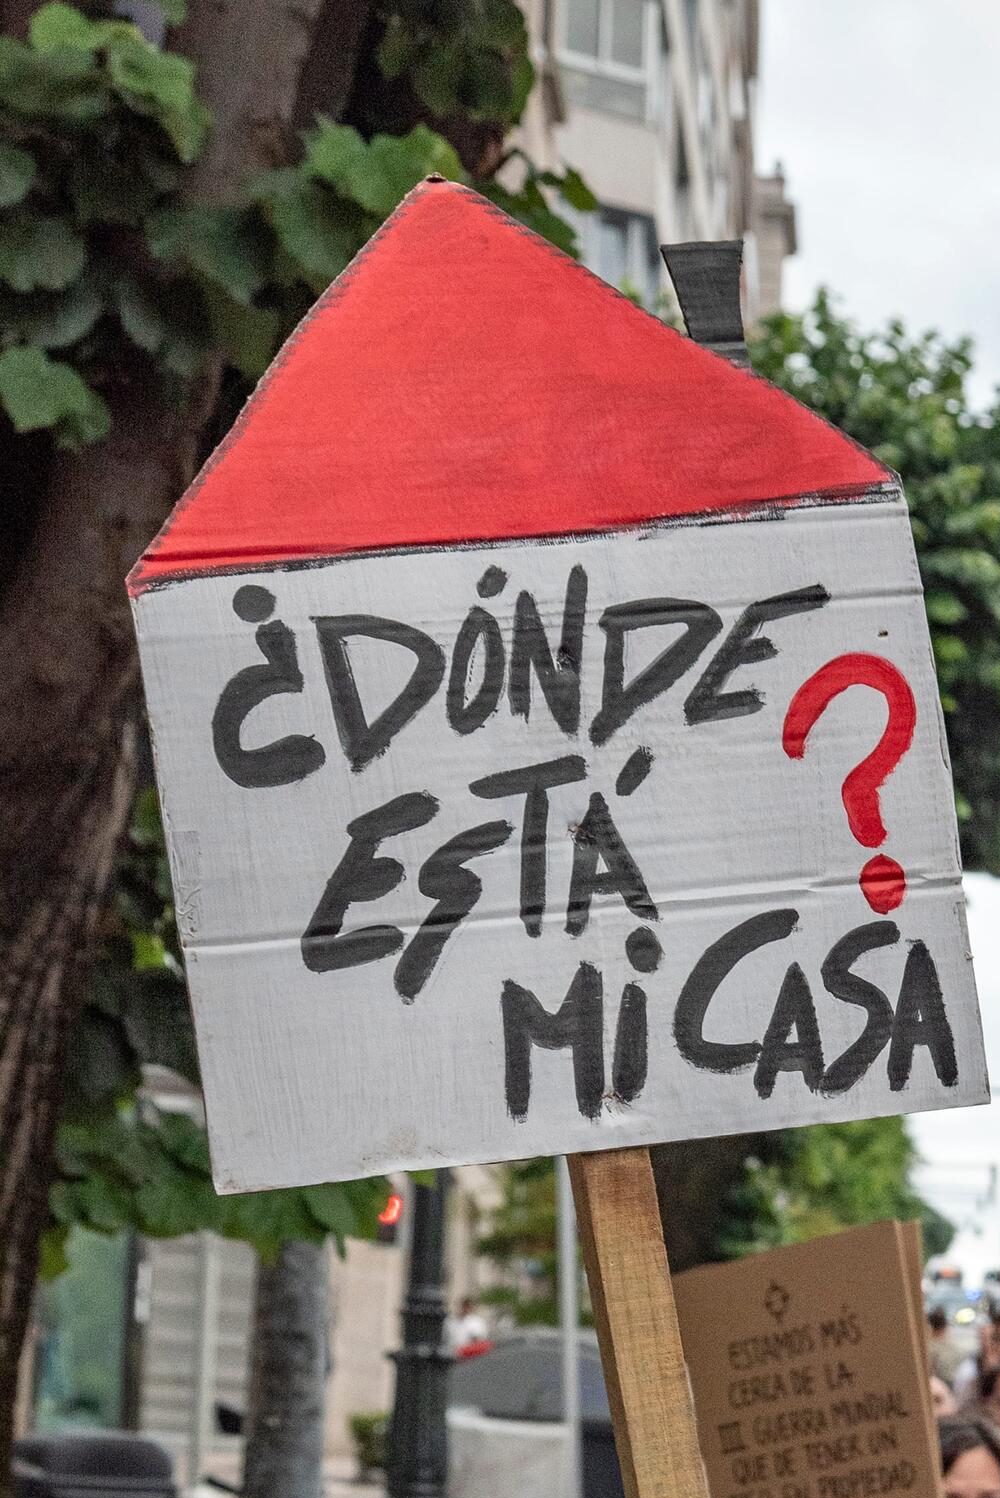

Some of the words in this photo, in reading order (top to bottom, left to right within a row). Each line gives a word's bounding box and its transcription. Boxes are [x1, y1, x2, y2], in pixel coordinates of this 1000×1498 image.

[212, 564, 831, 788] ¿DÓNDE
[300, 745, 660, 1005] ESTÁ
[672, 908, 960, 1100] CASA
[727, 1324, 816, 1371] ESTAMOS
[727, 1372, 787, 1409] CERCA
[788, 1365, 814, 1397] DE
[824, 1360, 853, 1389] LA
[731, 1455, 768, 1486] QUE
[773, 1450, 797, 1479] DE
[803, 1432, 860, 1470] TENER
[867, 1425, 898, 1455] UN
[752, 1407, 829, 1446] GUERRA
